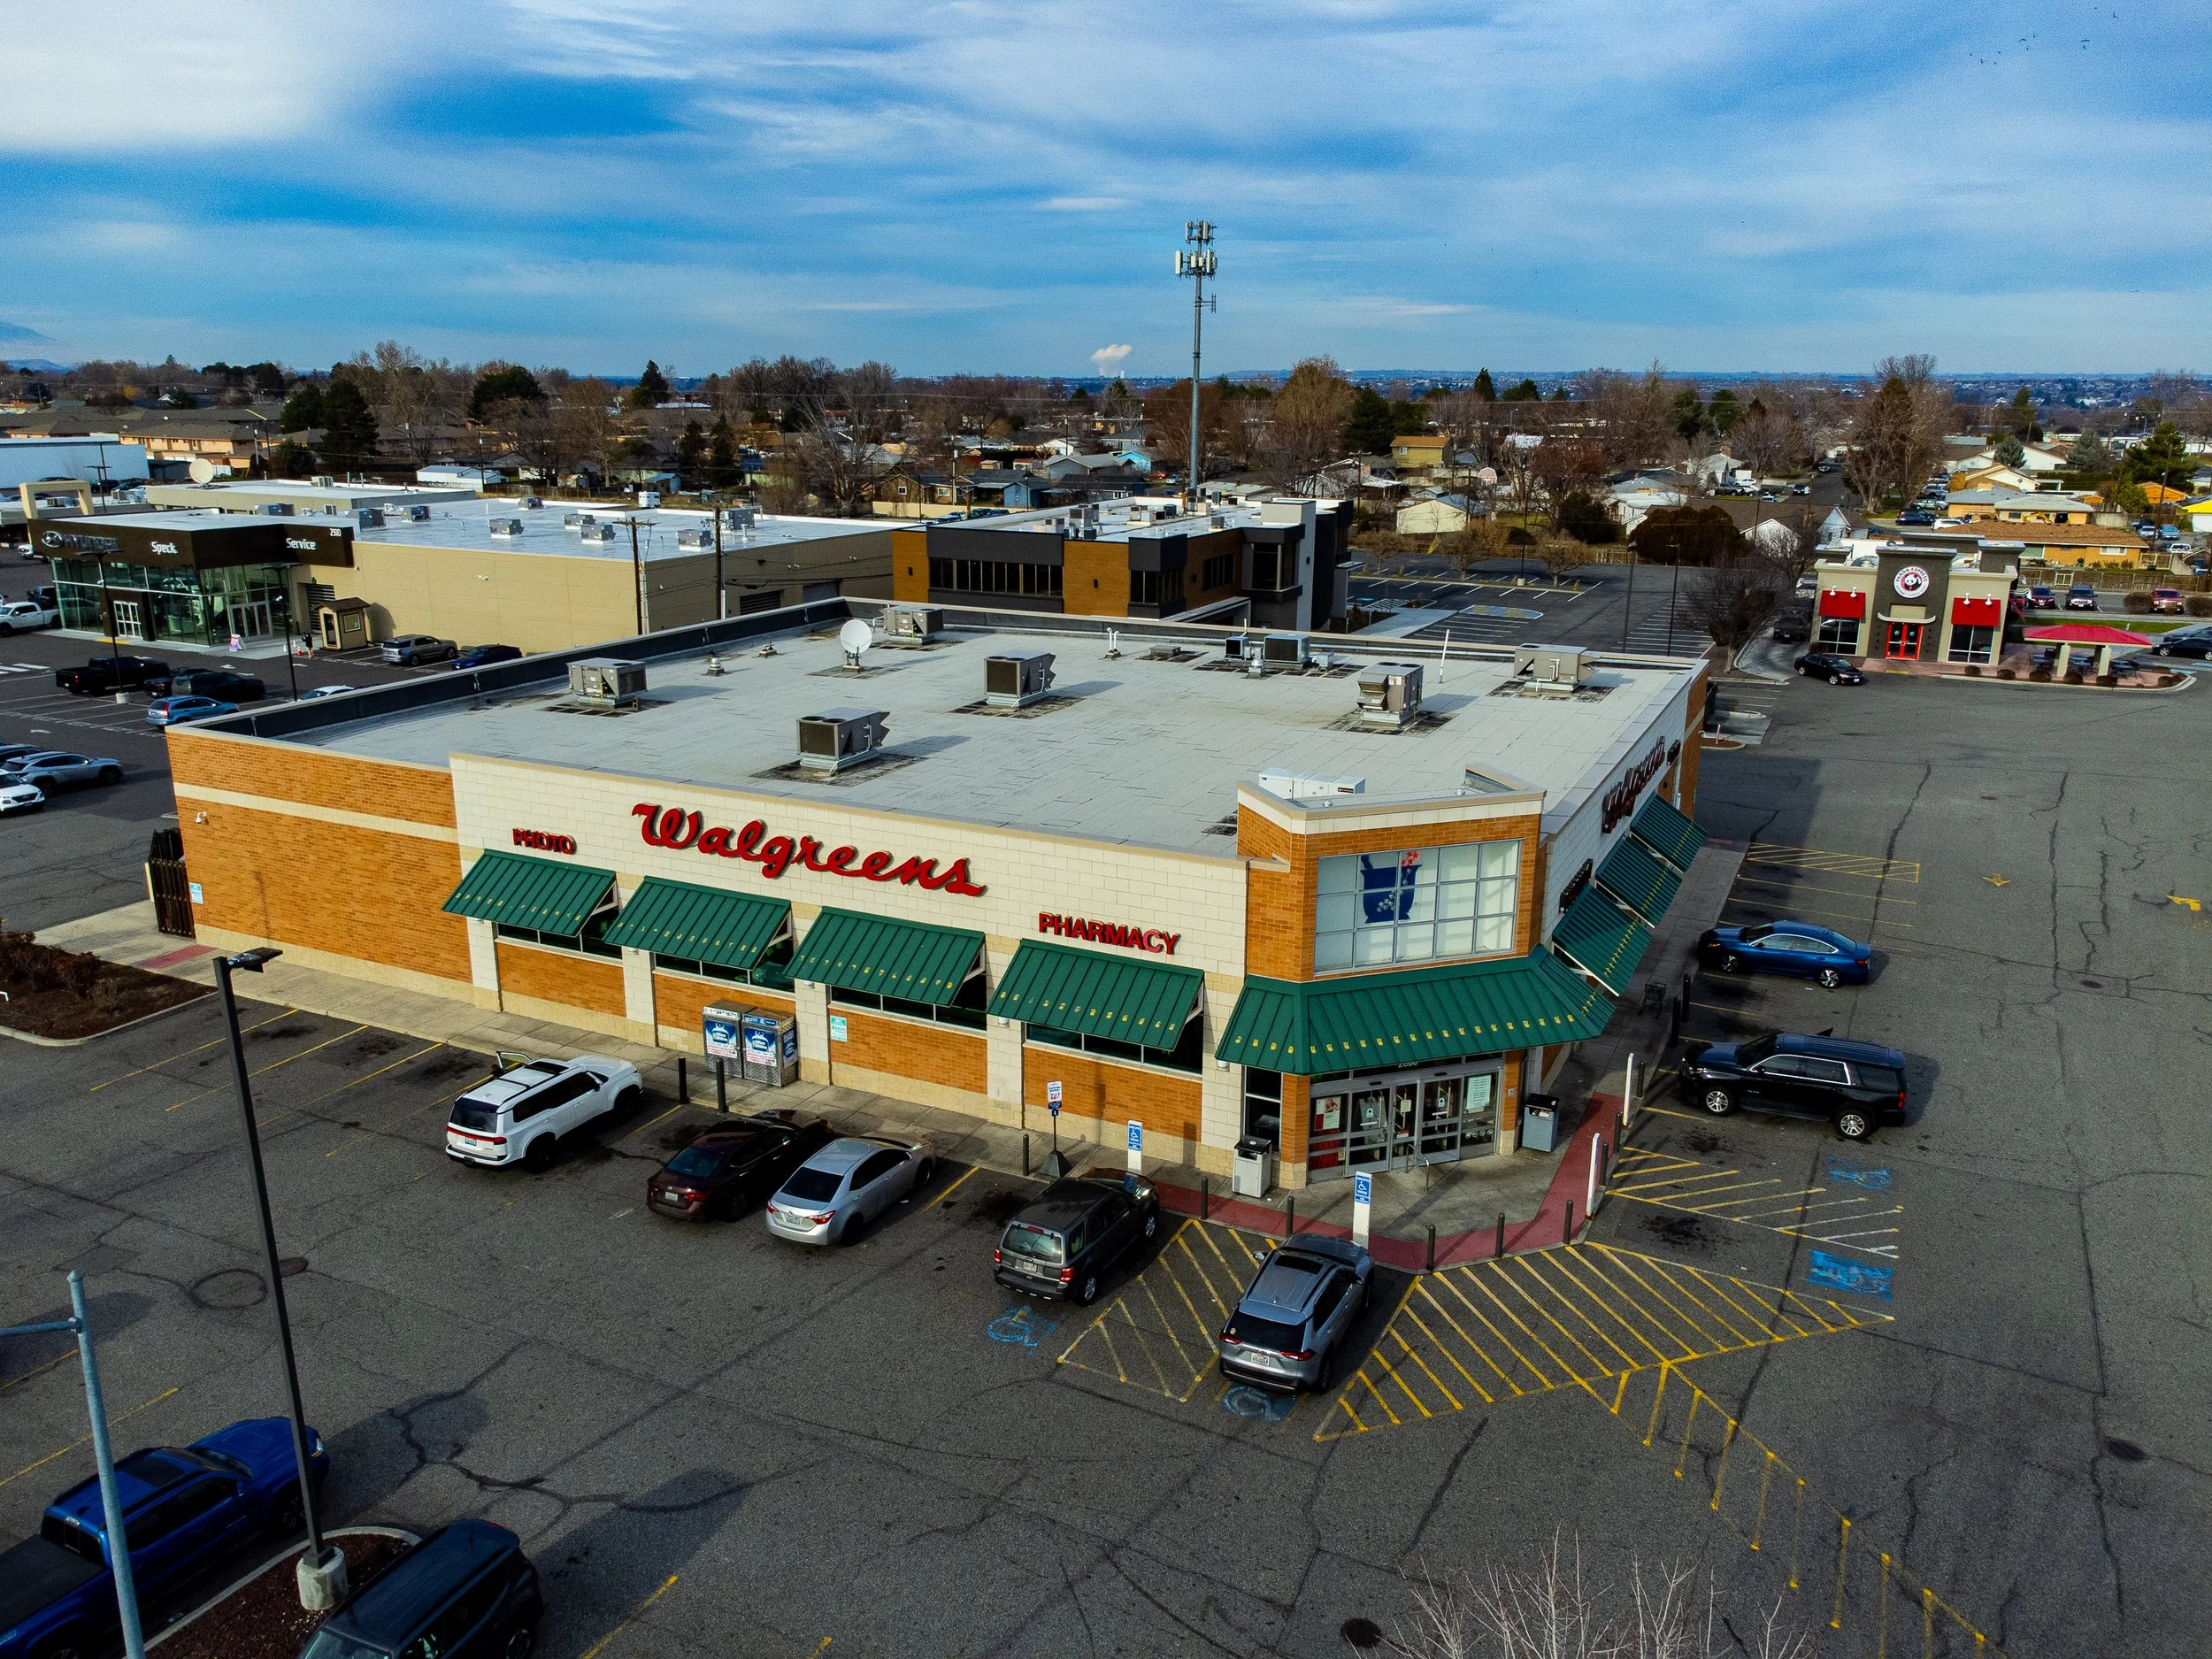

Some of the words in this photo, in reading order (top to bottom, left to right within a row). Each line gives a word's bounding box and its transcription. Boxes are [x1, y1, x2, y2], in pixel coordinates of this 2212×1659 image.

[150, 541, 178, 555] Speck
[286, 538, 317, 549] Service
[1896, 568, 1910, 582] PANDA
[1911, 567, 1928, 582] EXPRESS
[512, 828, 577, 855] PHOTO
[631, 803, 989, 897] Walgreens
[1039, 911, 1181, 955] PHARMACY
